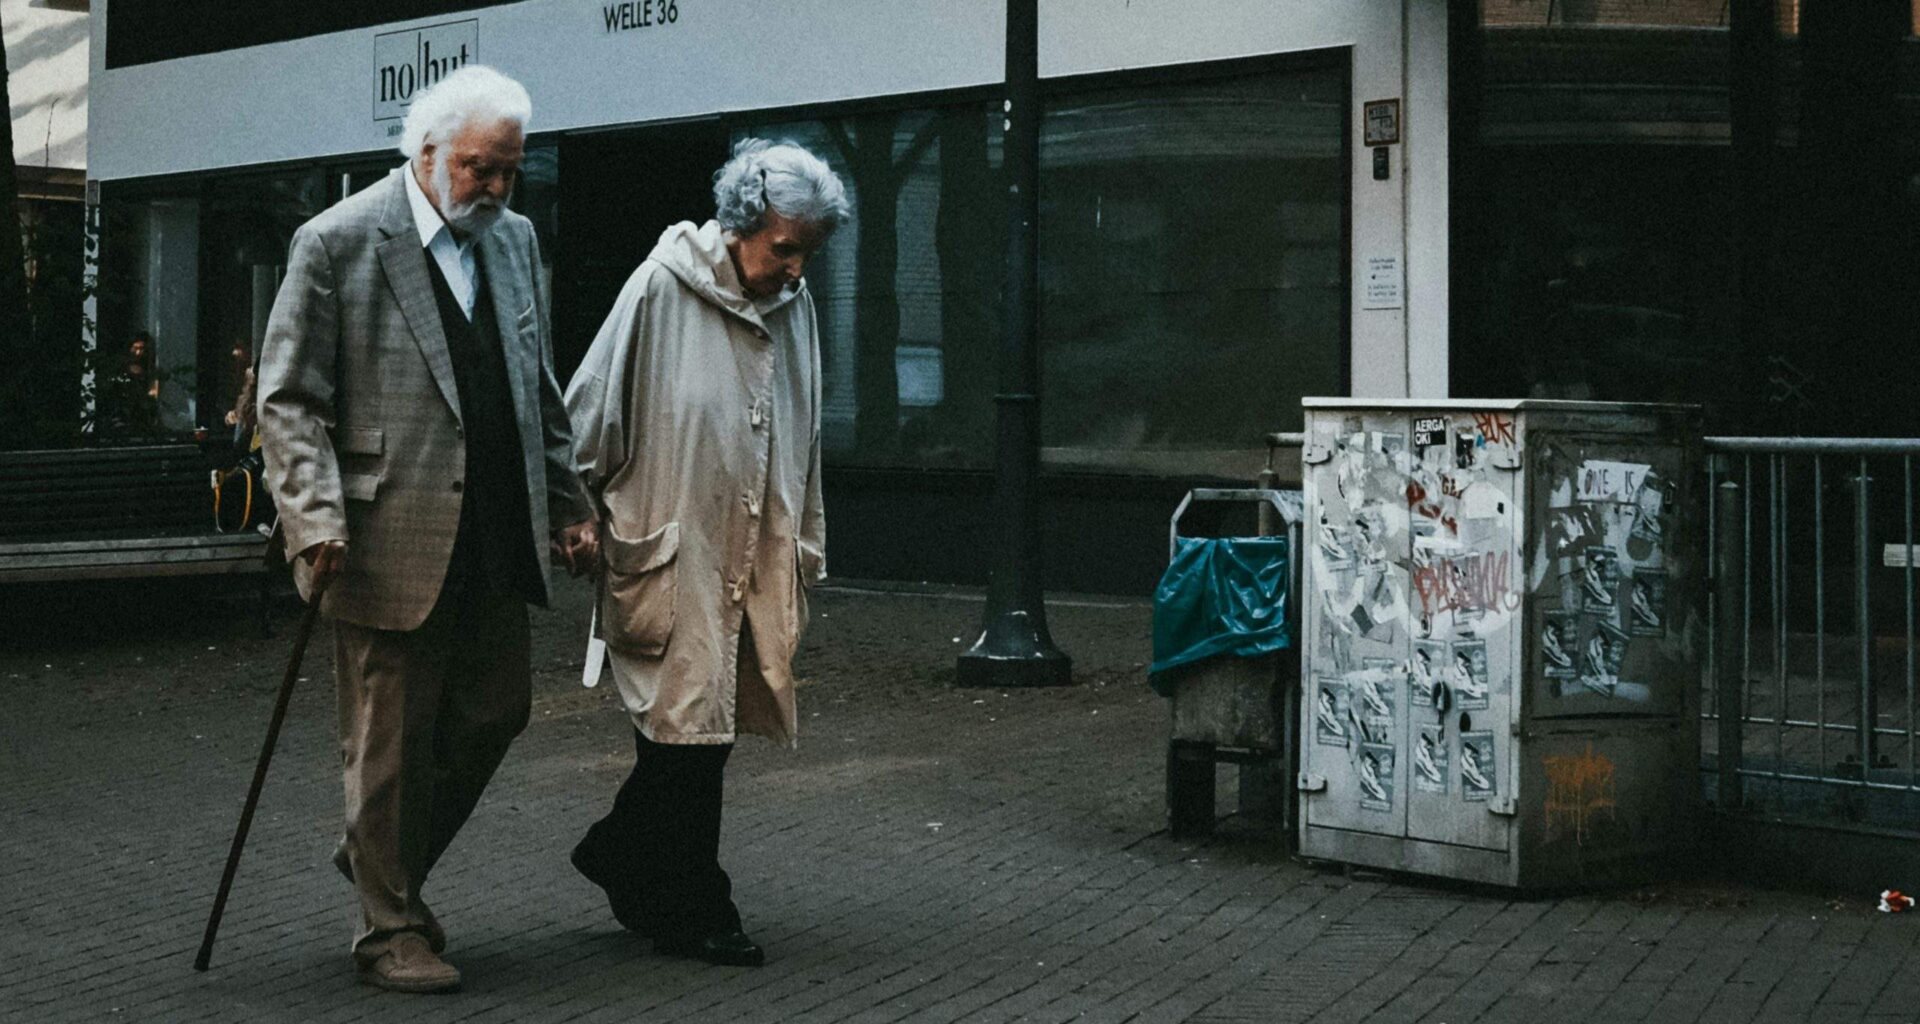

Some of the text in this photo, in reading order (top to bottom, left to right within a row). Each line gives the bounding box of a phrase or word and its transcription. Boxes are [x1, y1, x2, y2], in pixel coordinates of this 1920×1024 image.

[603, 0, 678, 33] WELLE 36
[1415, 418, 1445, 432] AERGA
[1584, 469, 1609, 495] ONE
